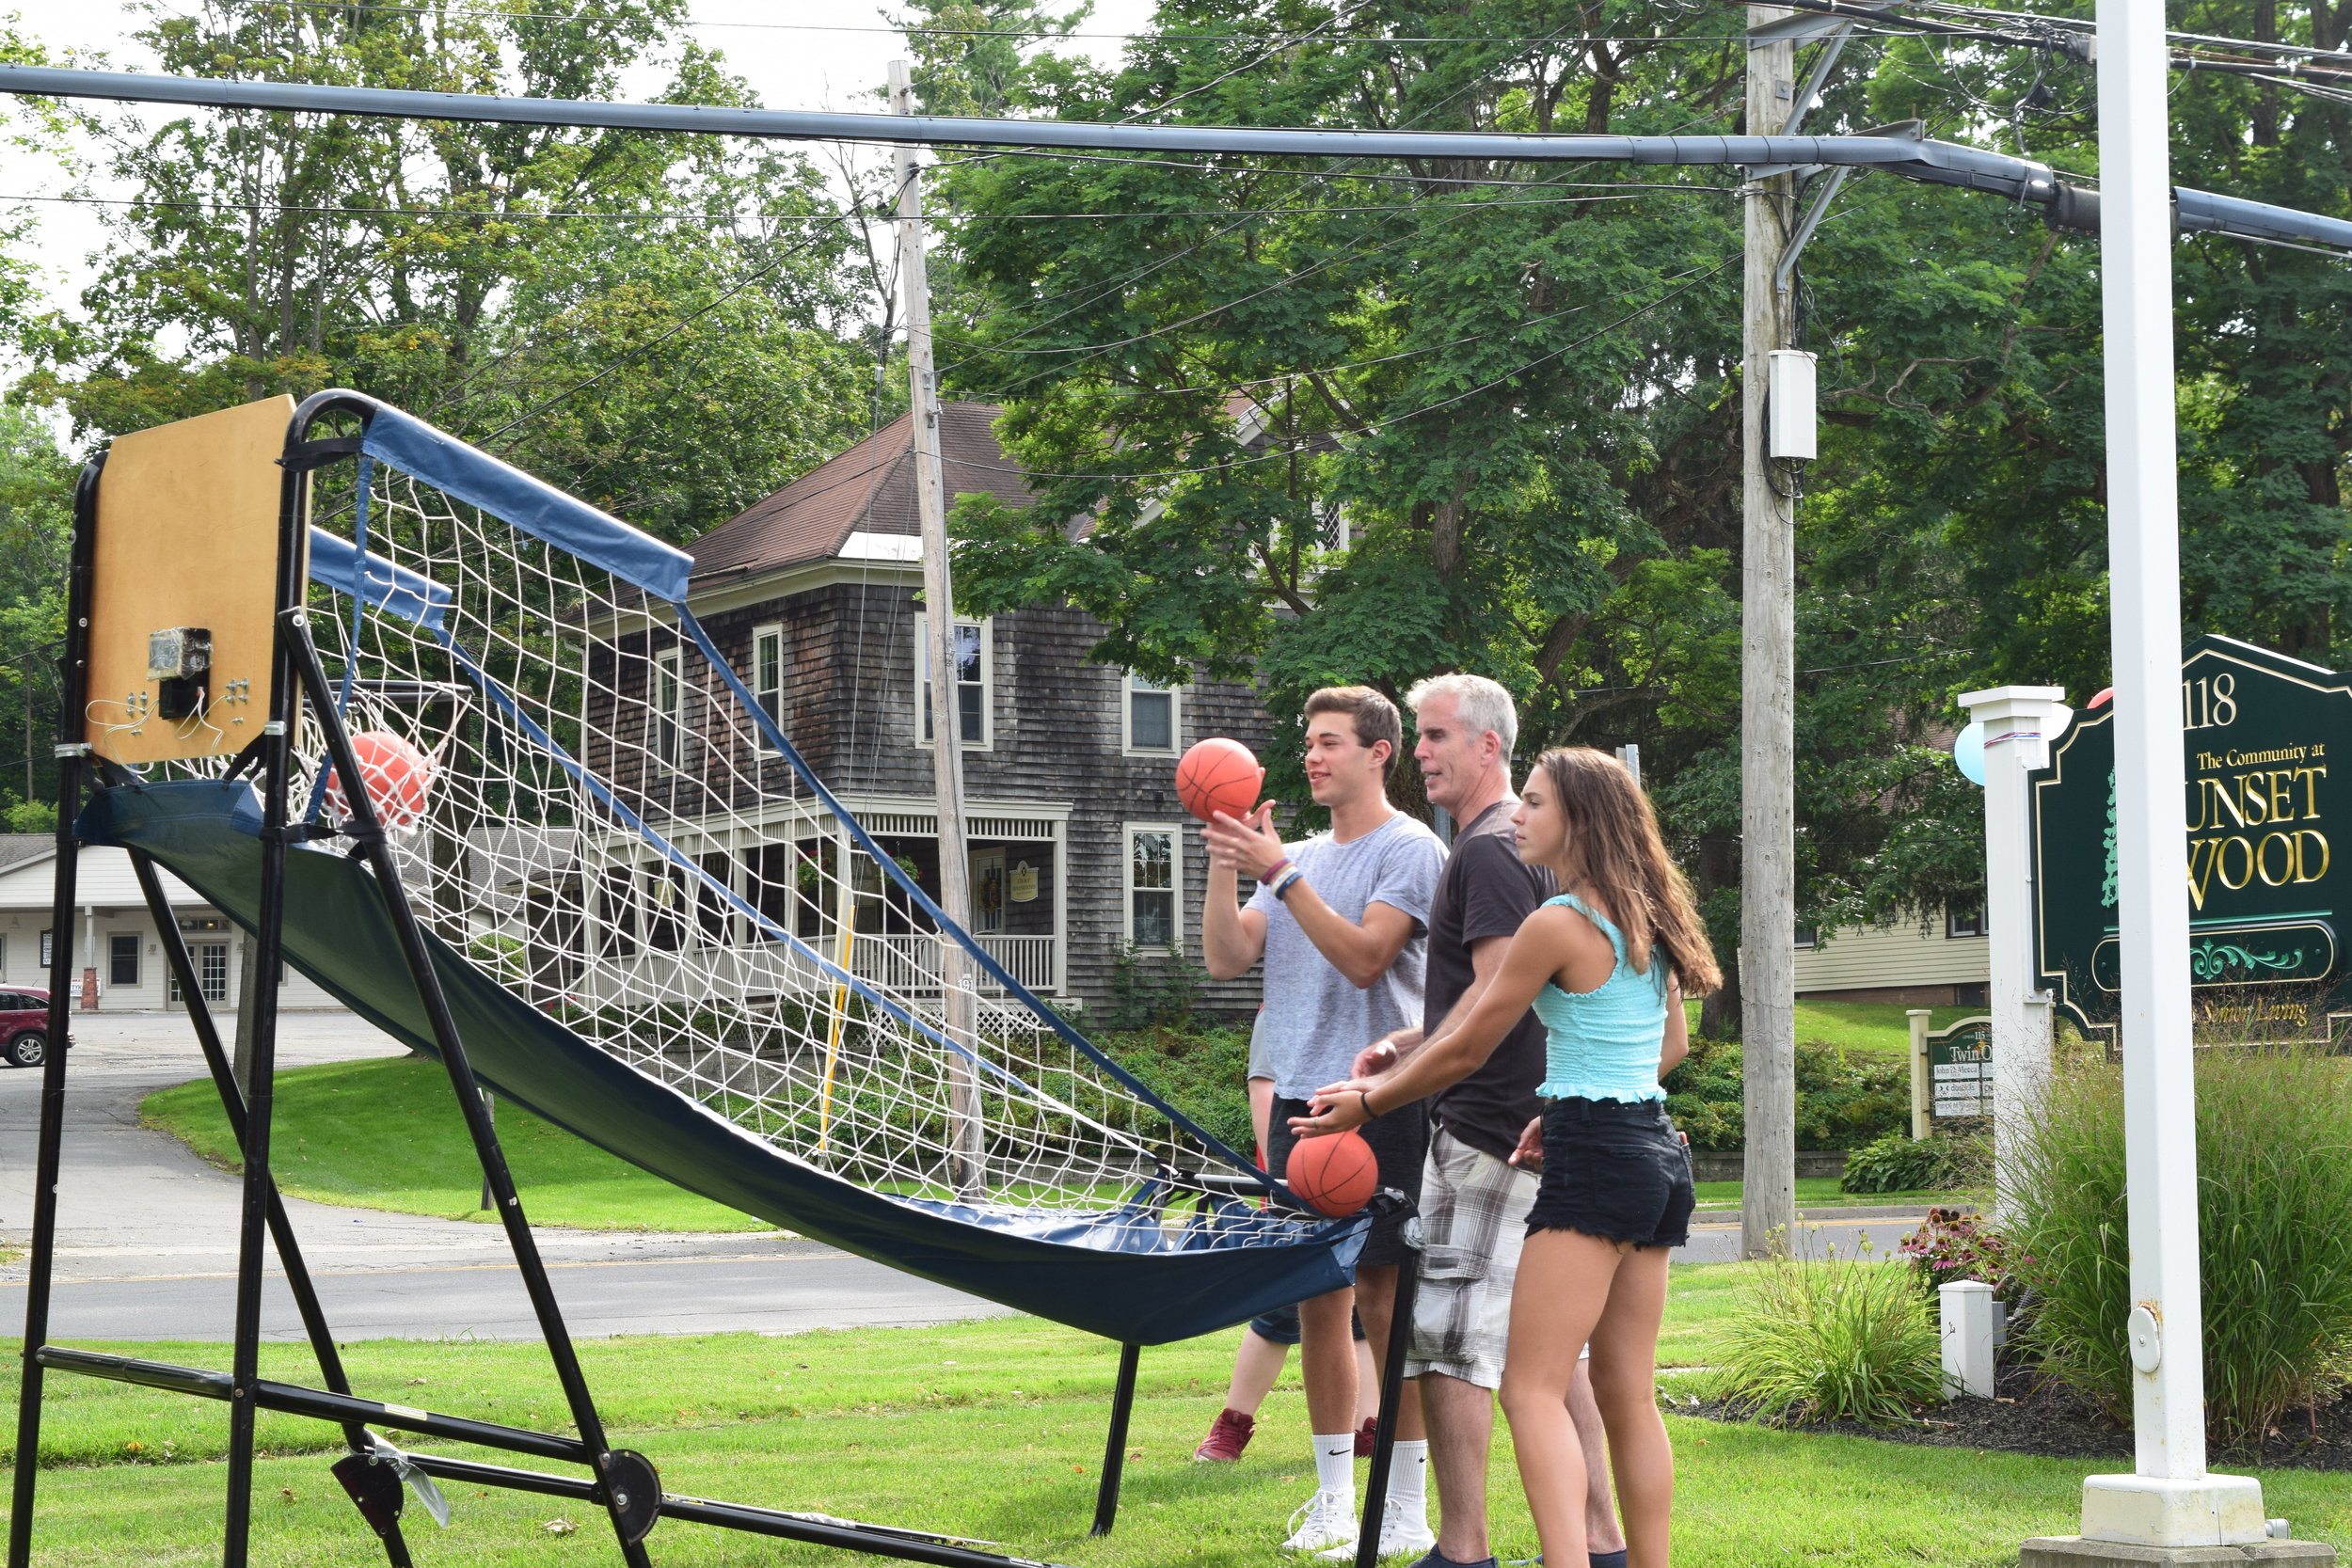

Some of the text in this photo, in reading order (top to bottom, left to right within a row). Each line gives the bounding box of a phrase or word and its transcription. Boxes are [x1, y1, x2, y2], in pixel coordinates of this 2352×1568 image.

[2182, 673, 2236, 731] 118
[2197, 741, 2325, 770] The Community at
[2185, 765, 2327, 832] UNSET
[2256, 996, 2308, 1027] Living
[1949, 1045, 1980, 1062] Twin
